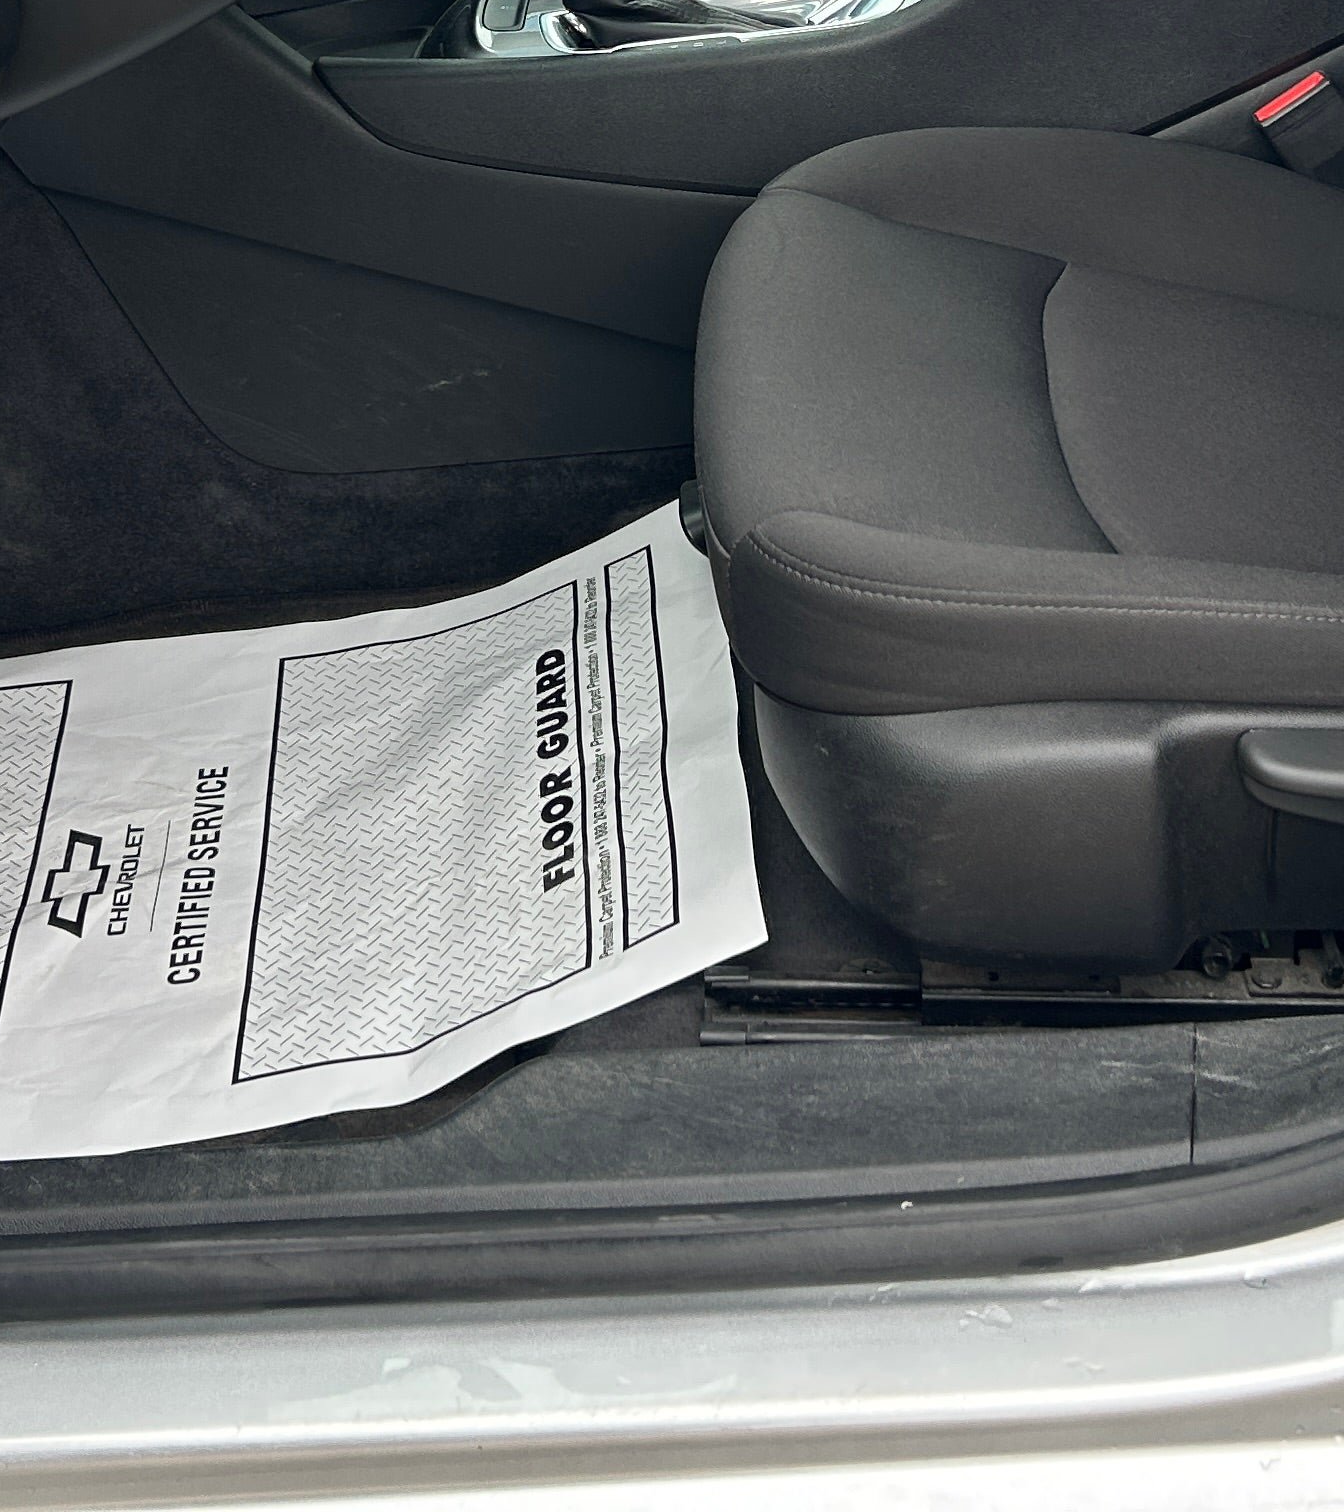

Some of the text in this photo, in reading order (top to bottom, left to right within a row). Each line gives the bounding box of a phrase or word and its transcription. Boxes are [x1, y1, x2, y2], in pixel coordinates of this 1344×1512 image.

[586, 653, 601, 689] Protection
[588, 688, 605, 714] Carpet
[590, 713, 604, 747] Premium
[536, 648, 575, 893] FLOOR GUARD
[592, 753, 606, 782] Reorder
[594, 780, 607, 791] to
[107, 824, 145, 936] CHEVROLET
[167, 766, 229, 985] CERTIFIED SERVICE
[597, 849, 612, 894] Protection
[598, 892, 616, 922] Carpet
[599, 920, 614, 960] Premium
